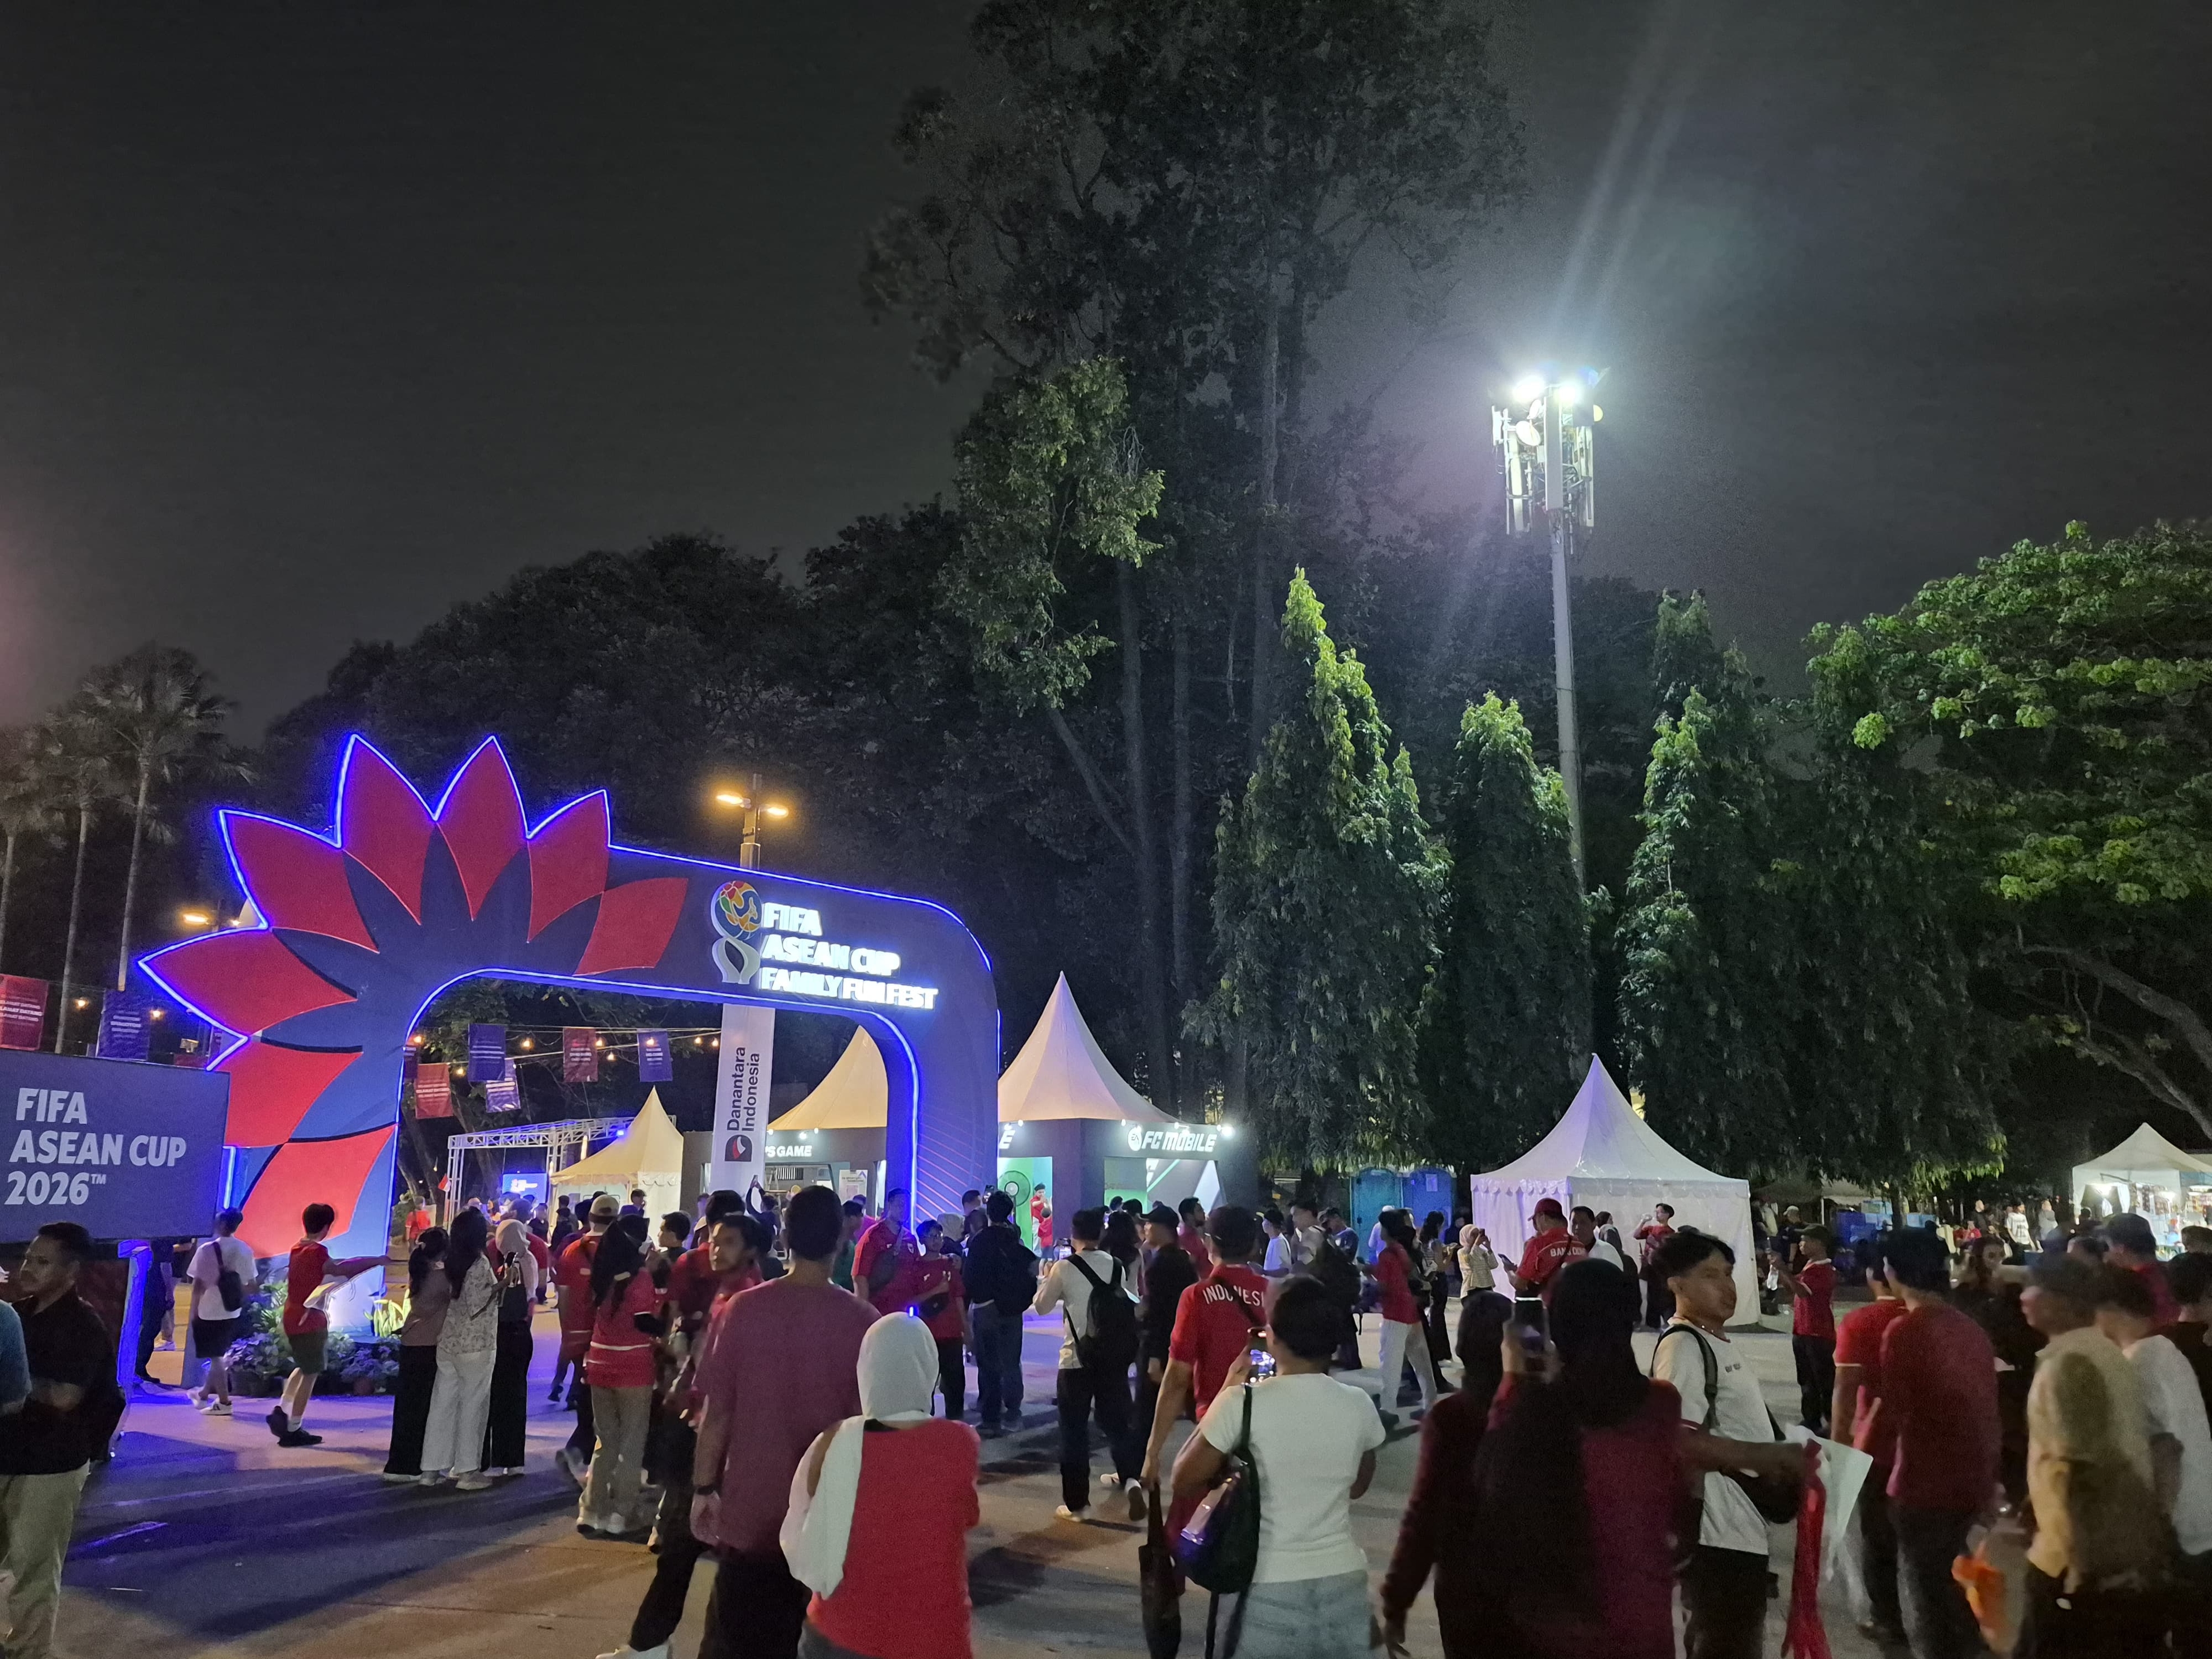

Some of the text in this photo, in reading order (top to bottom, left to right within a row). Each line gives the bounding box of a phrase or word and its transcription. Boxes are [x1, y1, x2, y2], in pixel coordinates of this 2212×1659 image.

[762, 903, 823, 936] FIFA
[760, 934, 901, 976] ASEAN CUP
[759, 967, 938, 1009] FAMILY FUN FEST
[16, 1088, 87, 1124] FIFA
[727, 1047, 745, 1131] Danantara
[742, 1054, 760, 1131] Indonesia
[9, 1130, 187, 1166] ASEAN CUP
[777, 1145, 812, 1157] GAME
[1141, 1131, 1164, 1149] FC
[1162, 1131, 1217, 1152] MOBILE
